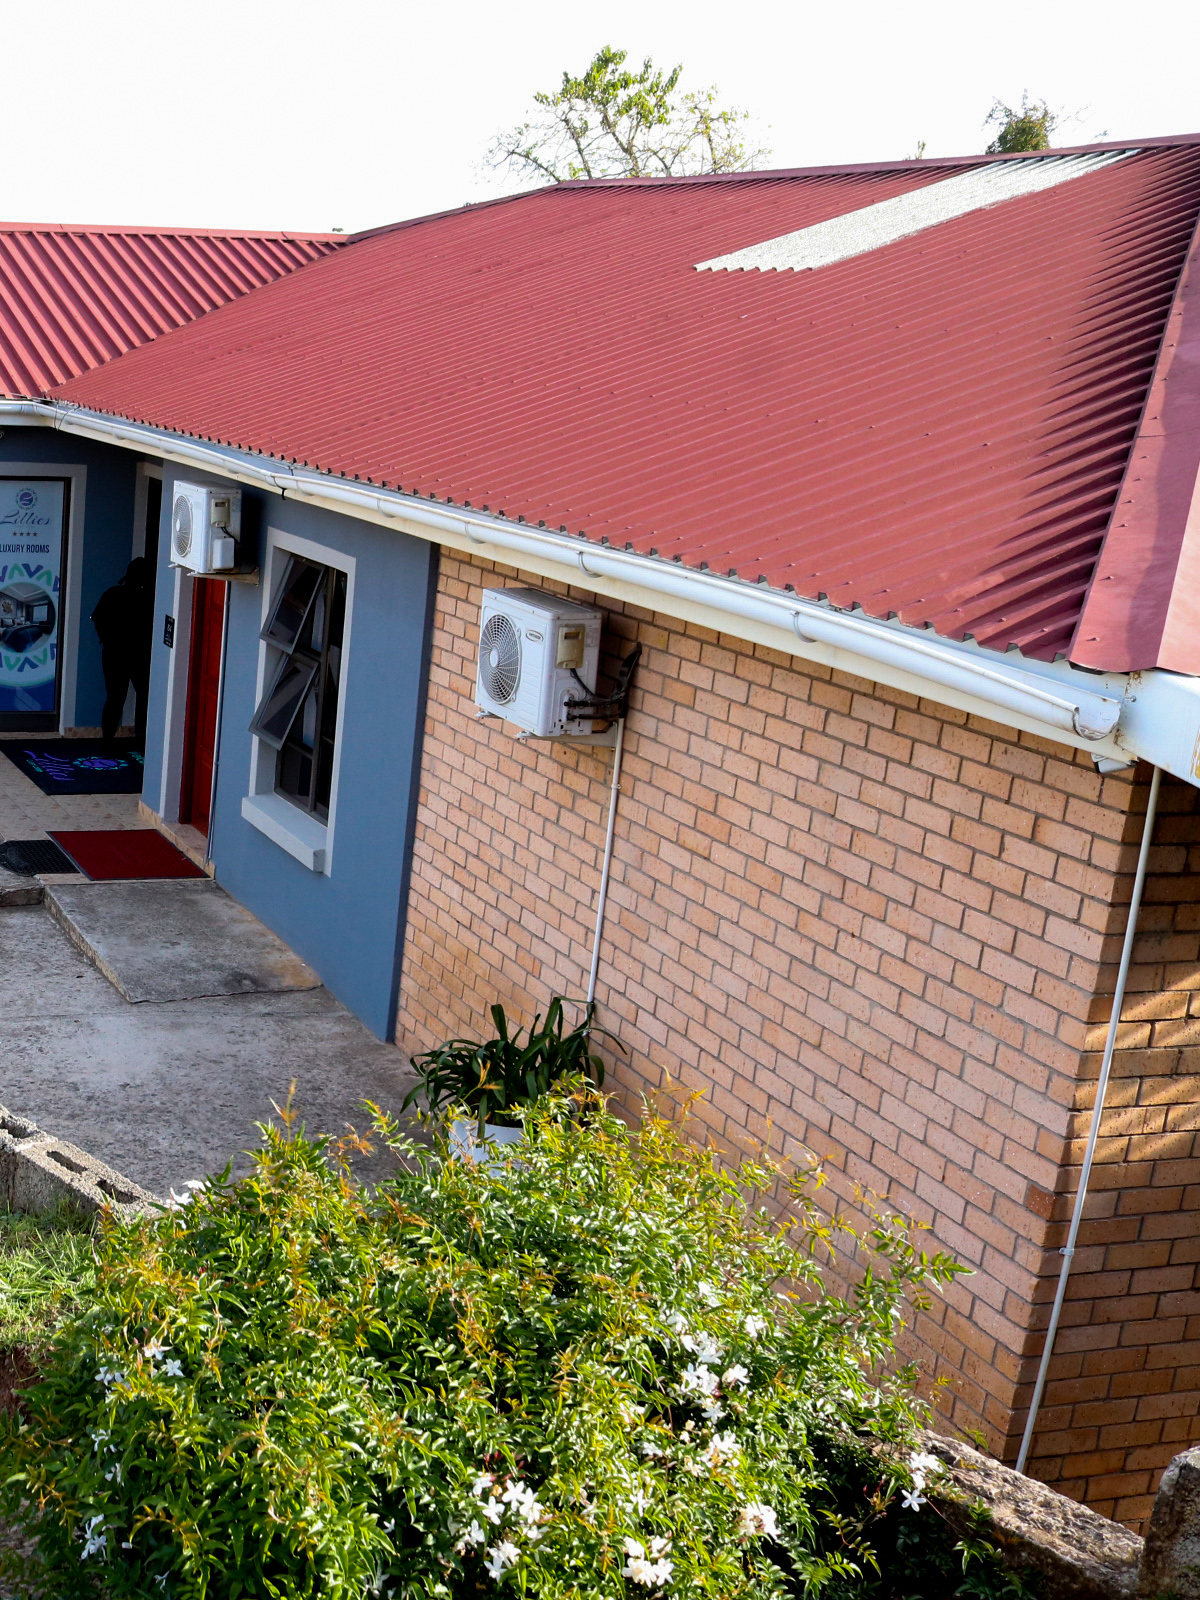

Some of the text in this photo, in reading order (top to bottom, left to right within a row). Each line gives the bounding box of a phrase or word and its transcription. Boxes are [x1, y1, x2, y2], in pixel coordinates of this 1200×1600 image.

[0, 509, 50, 525] Lillies
[0, 544, 50, 553] LUXURY ROOMS
